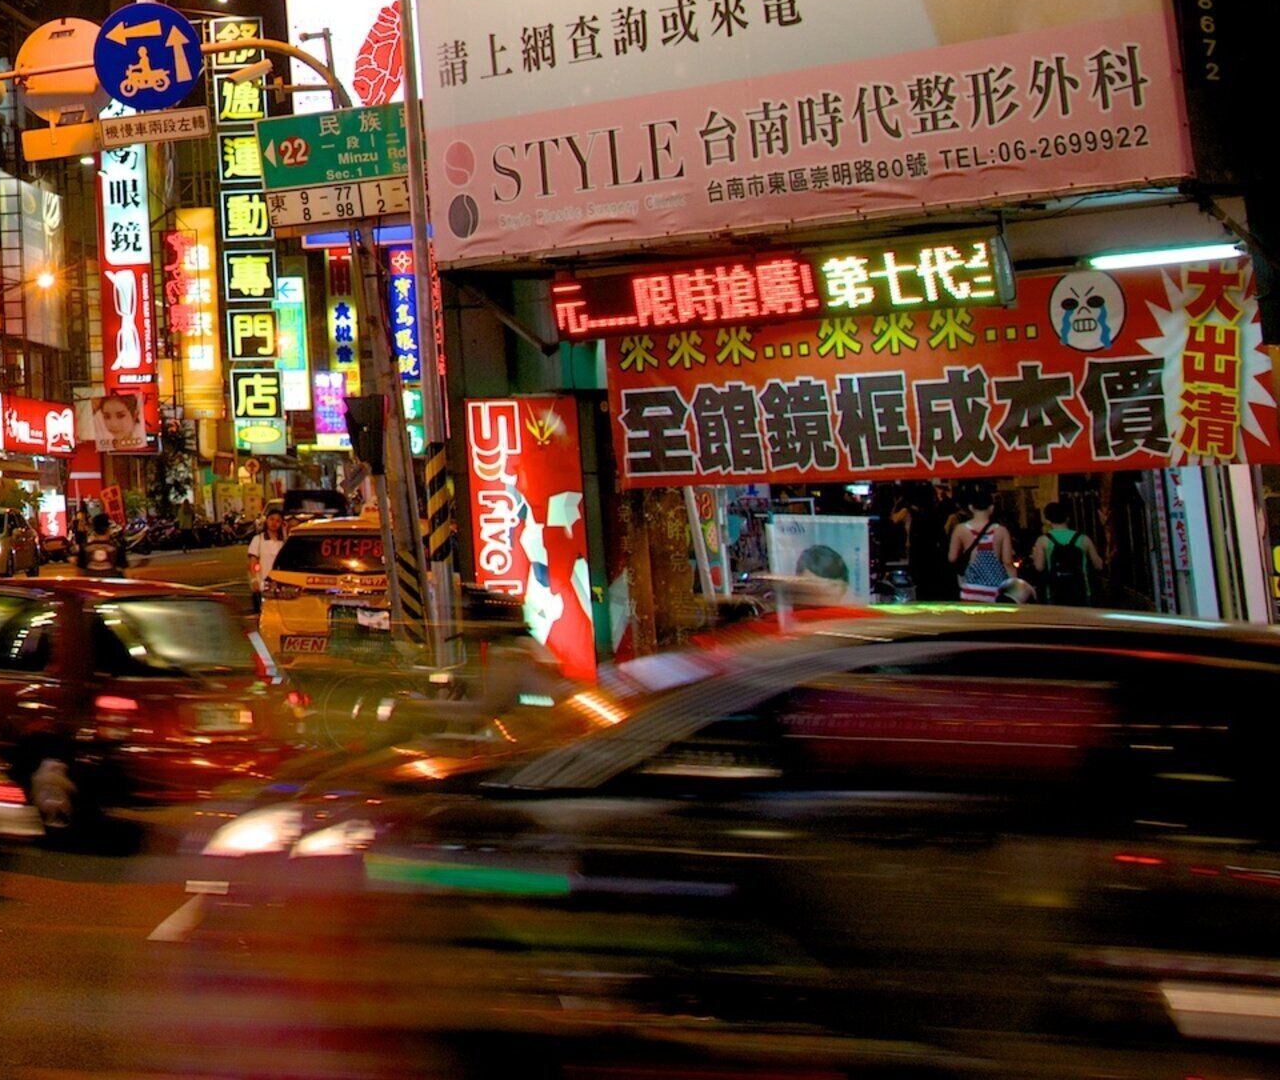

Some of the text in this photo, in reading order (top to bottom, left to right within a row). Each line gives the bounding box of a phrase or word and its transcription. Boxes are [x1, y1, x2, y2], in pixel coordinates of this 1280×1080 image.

[104, 112, 207, 141] 機慢車兩段左轉
[490, 42, 1150, 204] STYLE 台南時代整形外科
[279, 138, 309, 166] 22
[337, 151, 379, 165] Minzu
[705, 124, 1152, 204] 台南市東區崇明路80號 TEL:06-2699922
[269, 194, 288, 214] 東
[1178, 263, 1246, 460] 大出清
[618, 356, 1173, 478] 全館鏡框成本價
